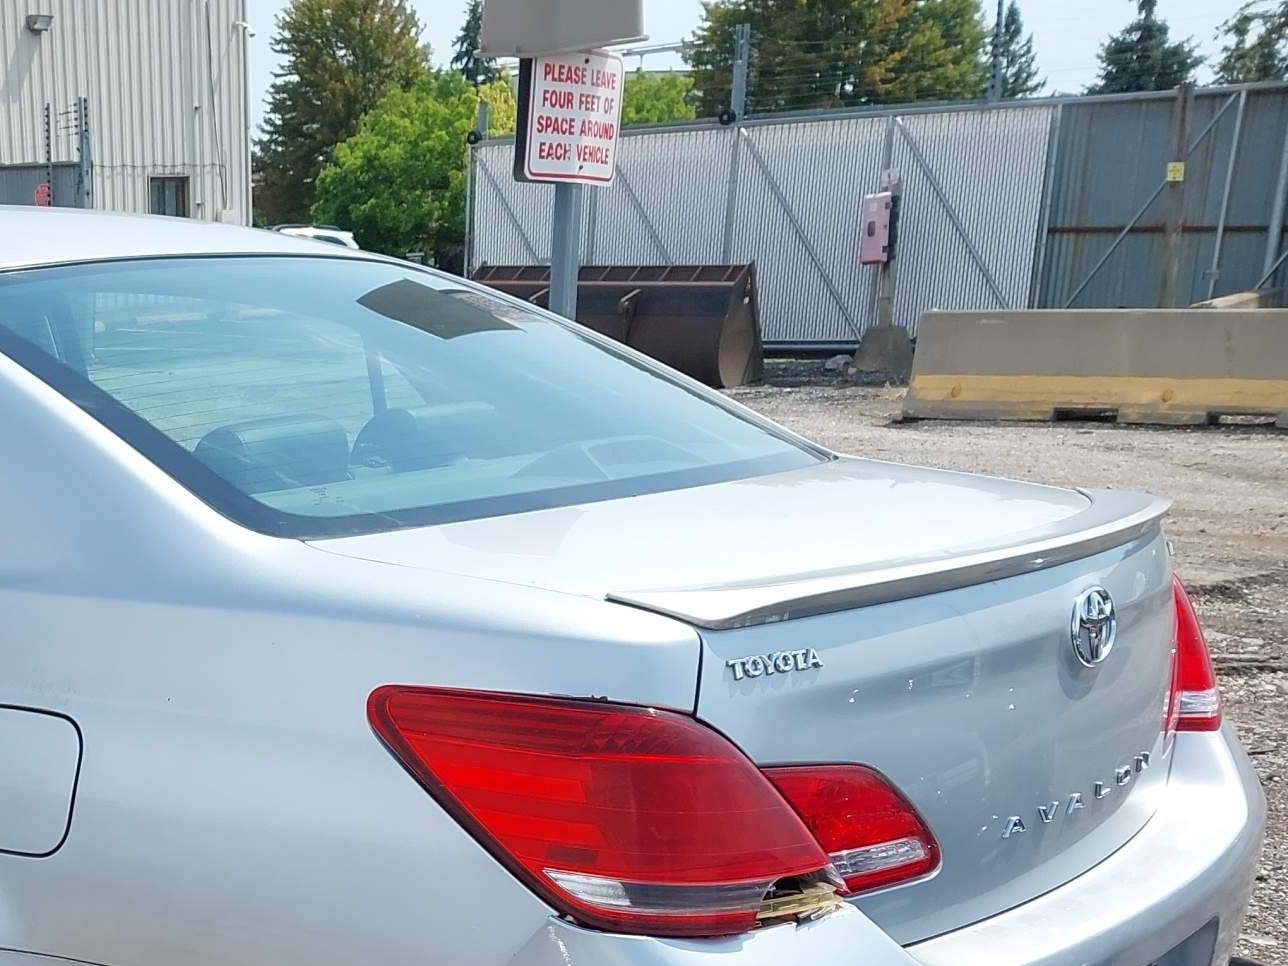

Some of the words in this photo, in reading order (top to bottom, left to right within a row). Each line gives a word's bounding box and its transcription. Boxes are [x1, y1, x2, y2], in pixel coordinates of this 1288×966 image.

[543, 62, 588, 86] PLEASE
[590, 68, 617, 91] LEAVE
[542, 89, 575, 110] FOUR
[578, 92, 601, 113] FEET
[603, 96, 614, 116] OF
[536, 114, 576, 136] SPACE
[579, 119, 615, 141] AROUND
[538, 141, 572, 161] EACH
[576, 143, 610, 165] VEHICLE
[726, 648, 824, 681] TOYOTA
[1001, 751, 1150, 839] AVALON
